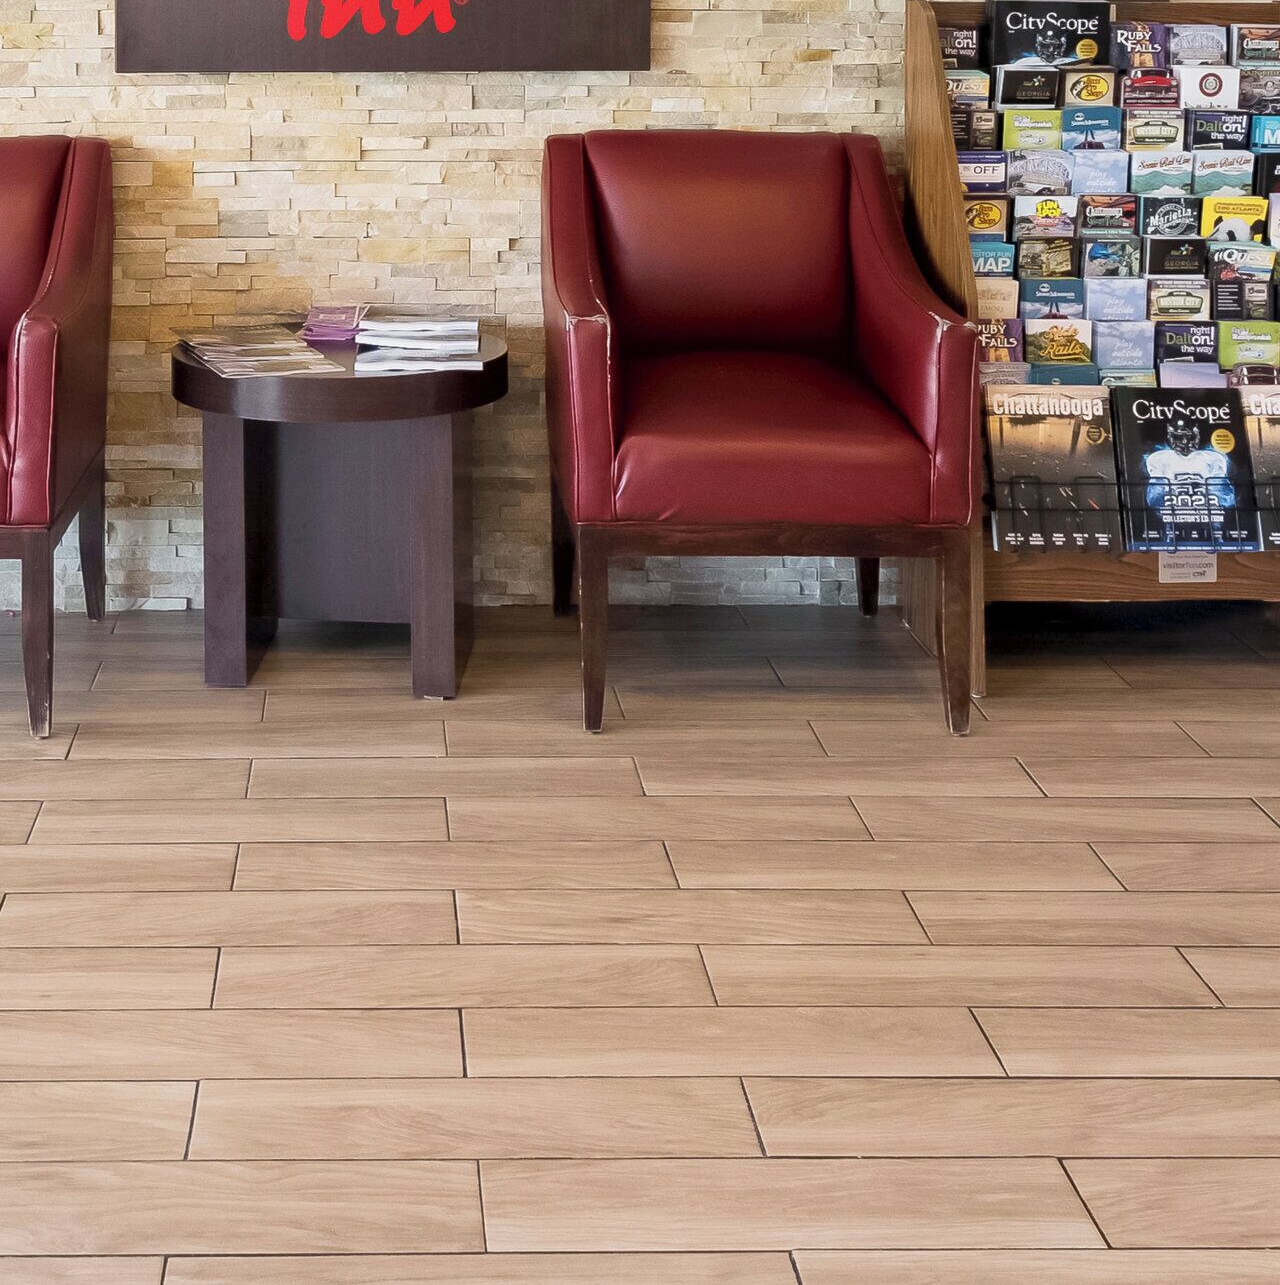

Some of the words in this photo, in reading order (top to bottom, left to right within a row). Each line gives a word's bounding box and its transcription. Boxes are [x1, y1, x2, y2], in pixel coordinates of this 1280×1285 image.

[1117, 30, 1152, 45] RUBY
[1126, 41, 1162, 53] FALLS
[1221, 115, 1243, 126] right
[974, 165, 1000, 175] OFF
[1190, 327, 1211, 335] right
[980, 335, 1018, 347] FALLS
[1180, 345, 1194, 353] the
[1196, 347, 1214, 355] way
[992, 393, 1104, 421] Chattanooga
